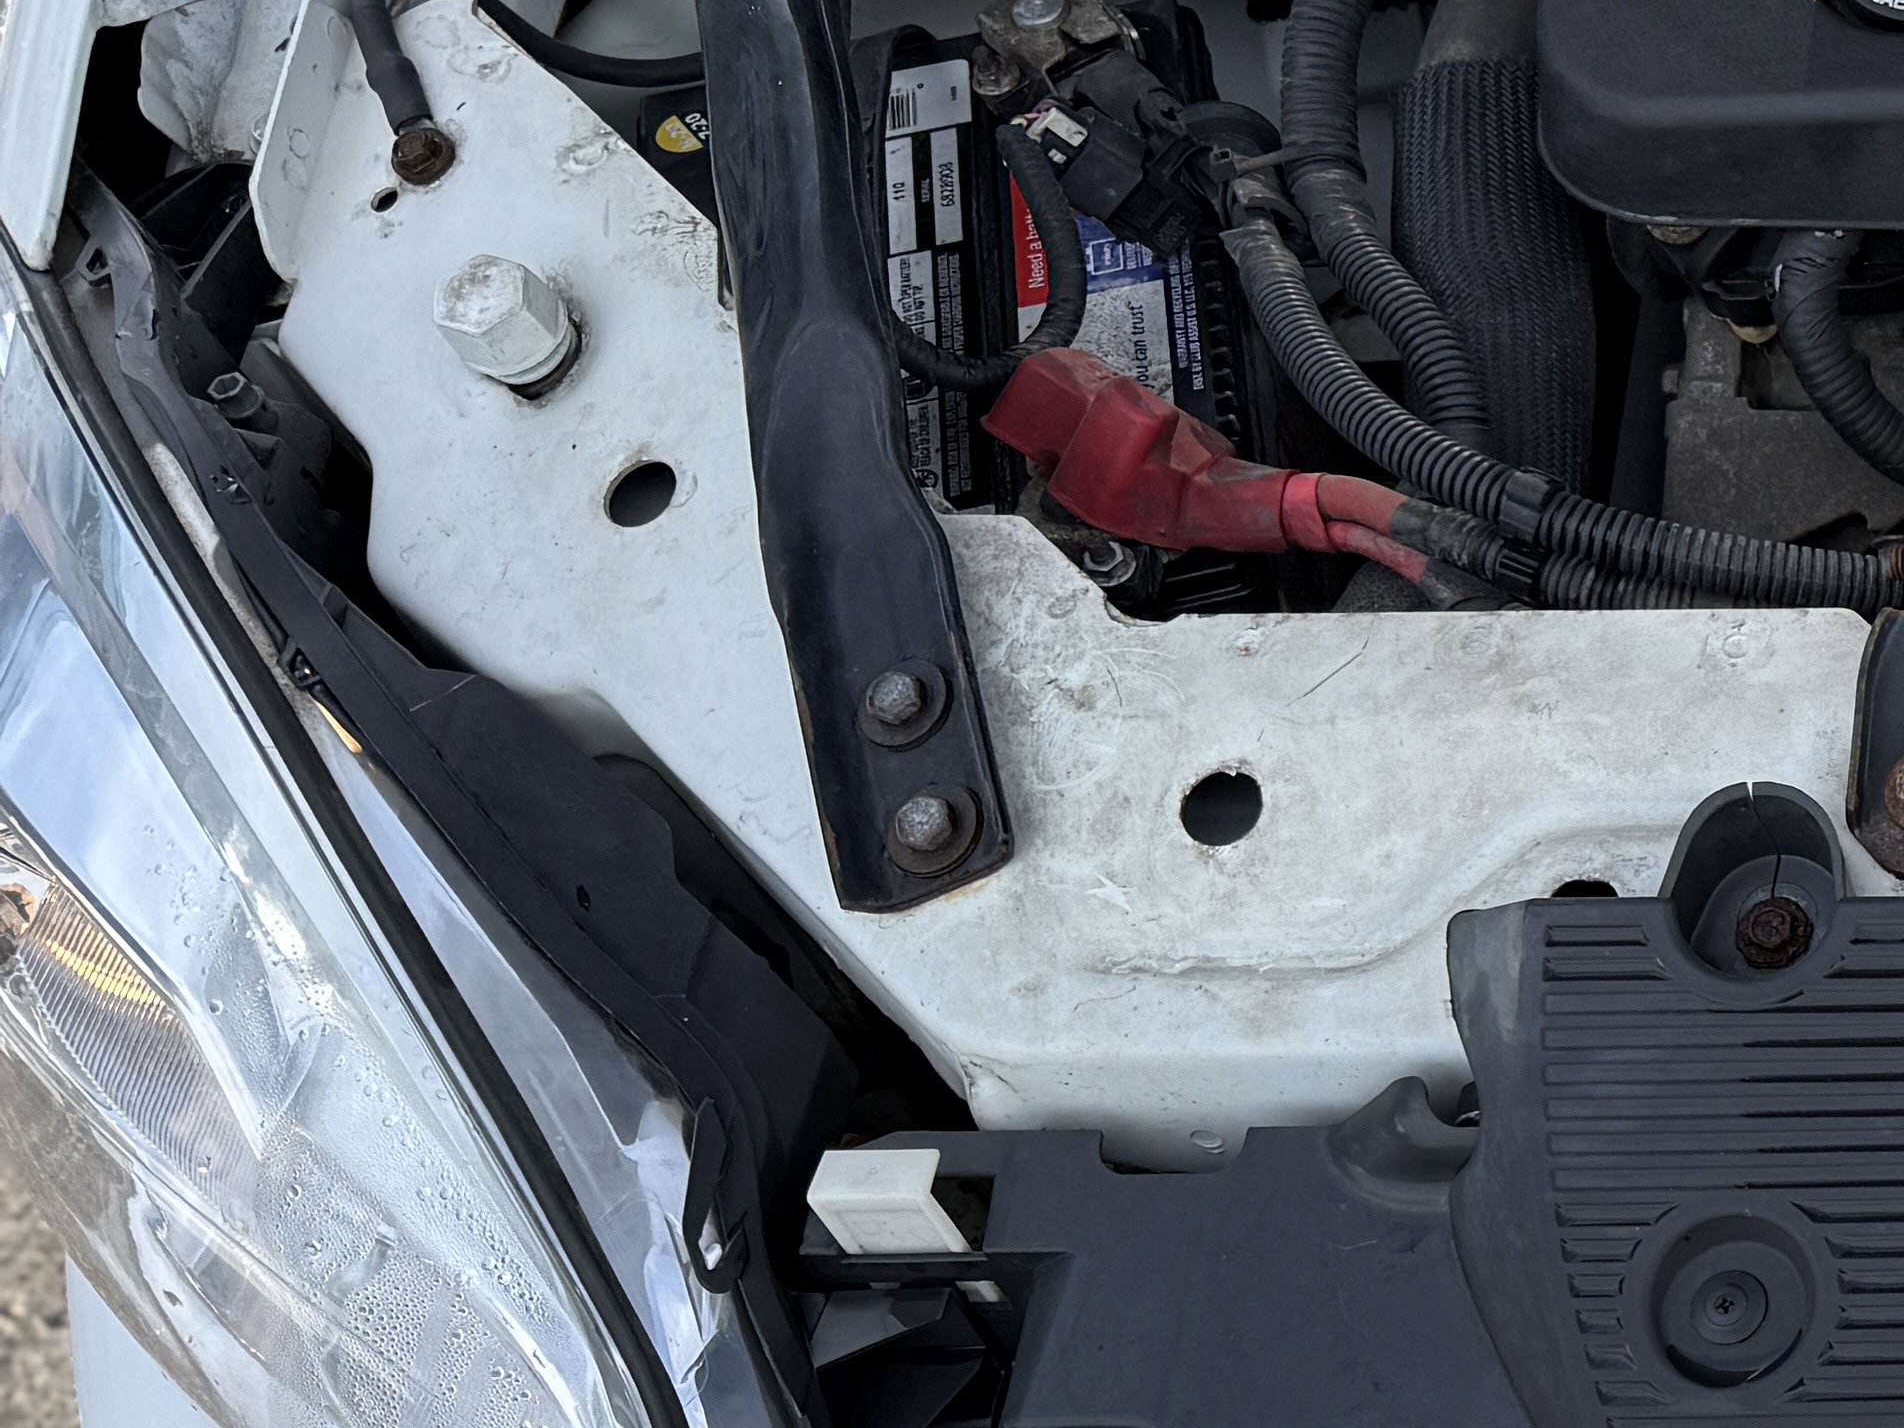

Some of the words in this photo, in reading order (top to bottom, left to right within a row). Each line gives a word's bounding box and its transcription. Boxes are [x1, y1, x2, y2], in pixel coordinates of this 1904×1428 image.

[1030, 243, 1042, 254] a
[1028, 257, 1045, 288] Need
[1132, 333, 1147, 361] can
